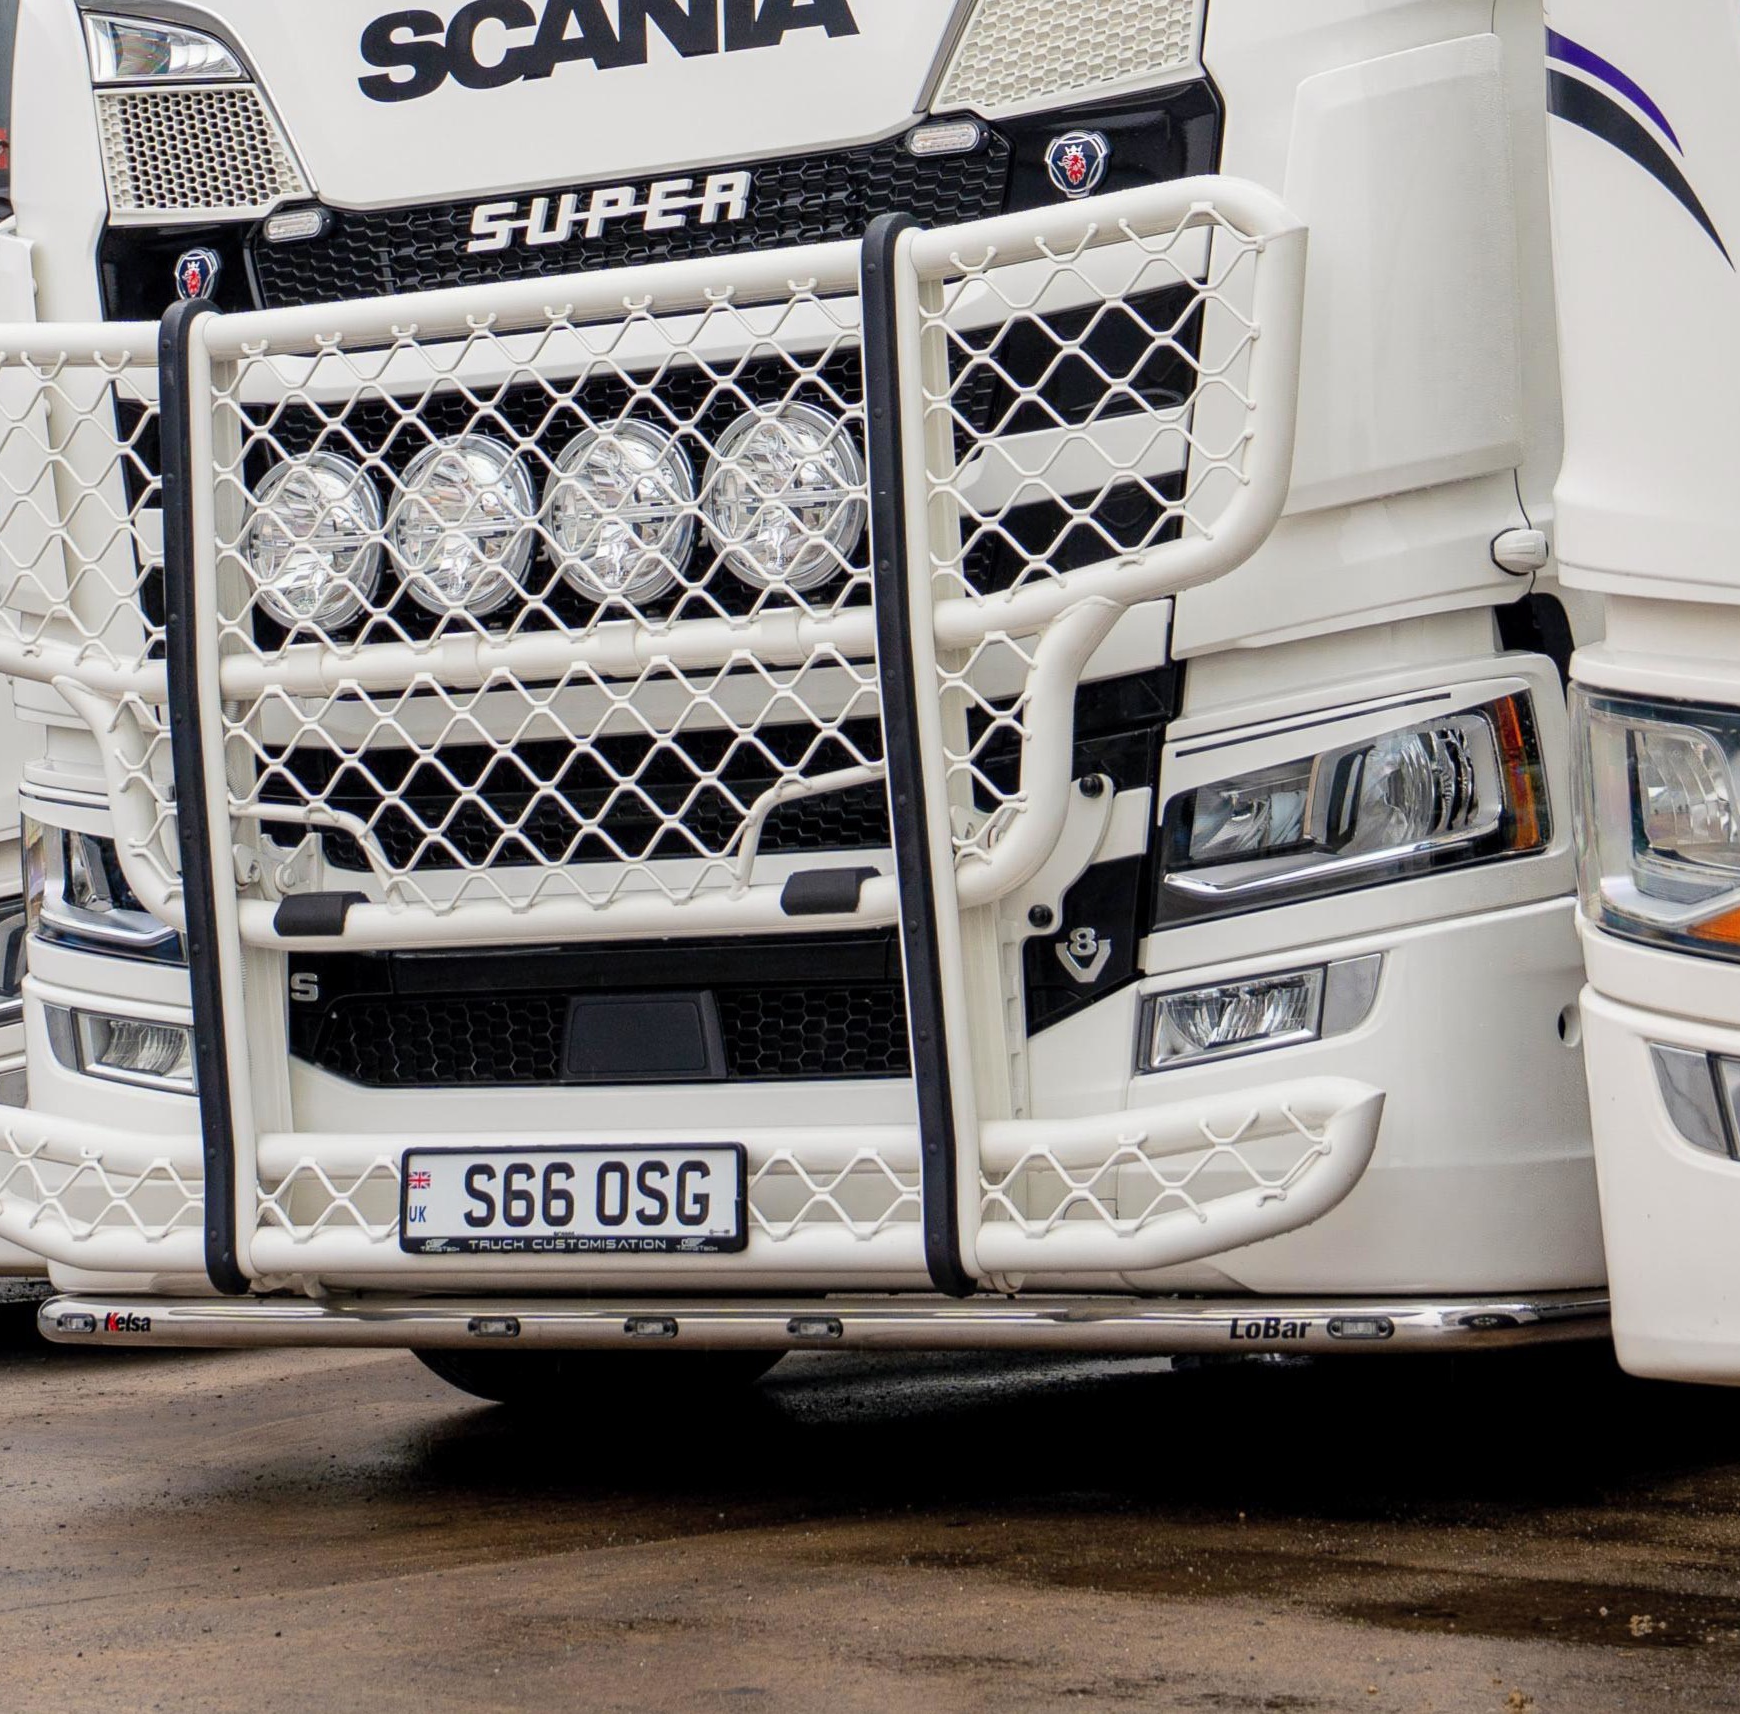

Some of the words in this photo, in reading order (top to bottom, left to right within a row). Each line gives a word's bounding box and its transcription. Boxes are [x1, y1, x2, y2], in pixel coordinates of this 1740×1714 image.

[467, 171, 751, 254] SUPER
[463, 1161, 576, 1228] S66
[409, 1205, 427, 1223] UK
[468, 1239, 525, 1251] TRUCK
[532, 1239, 666, 1251] CUSTOMISATION
[104, 1312, 151, 1332] Kelsa
[1228, 1316, 1312, 1342] LoBar
